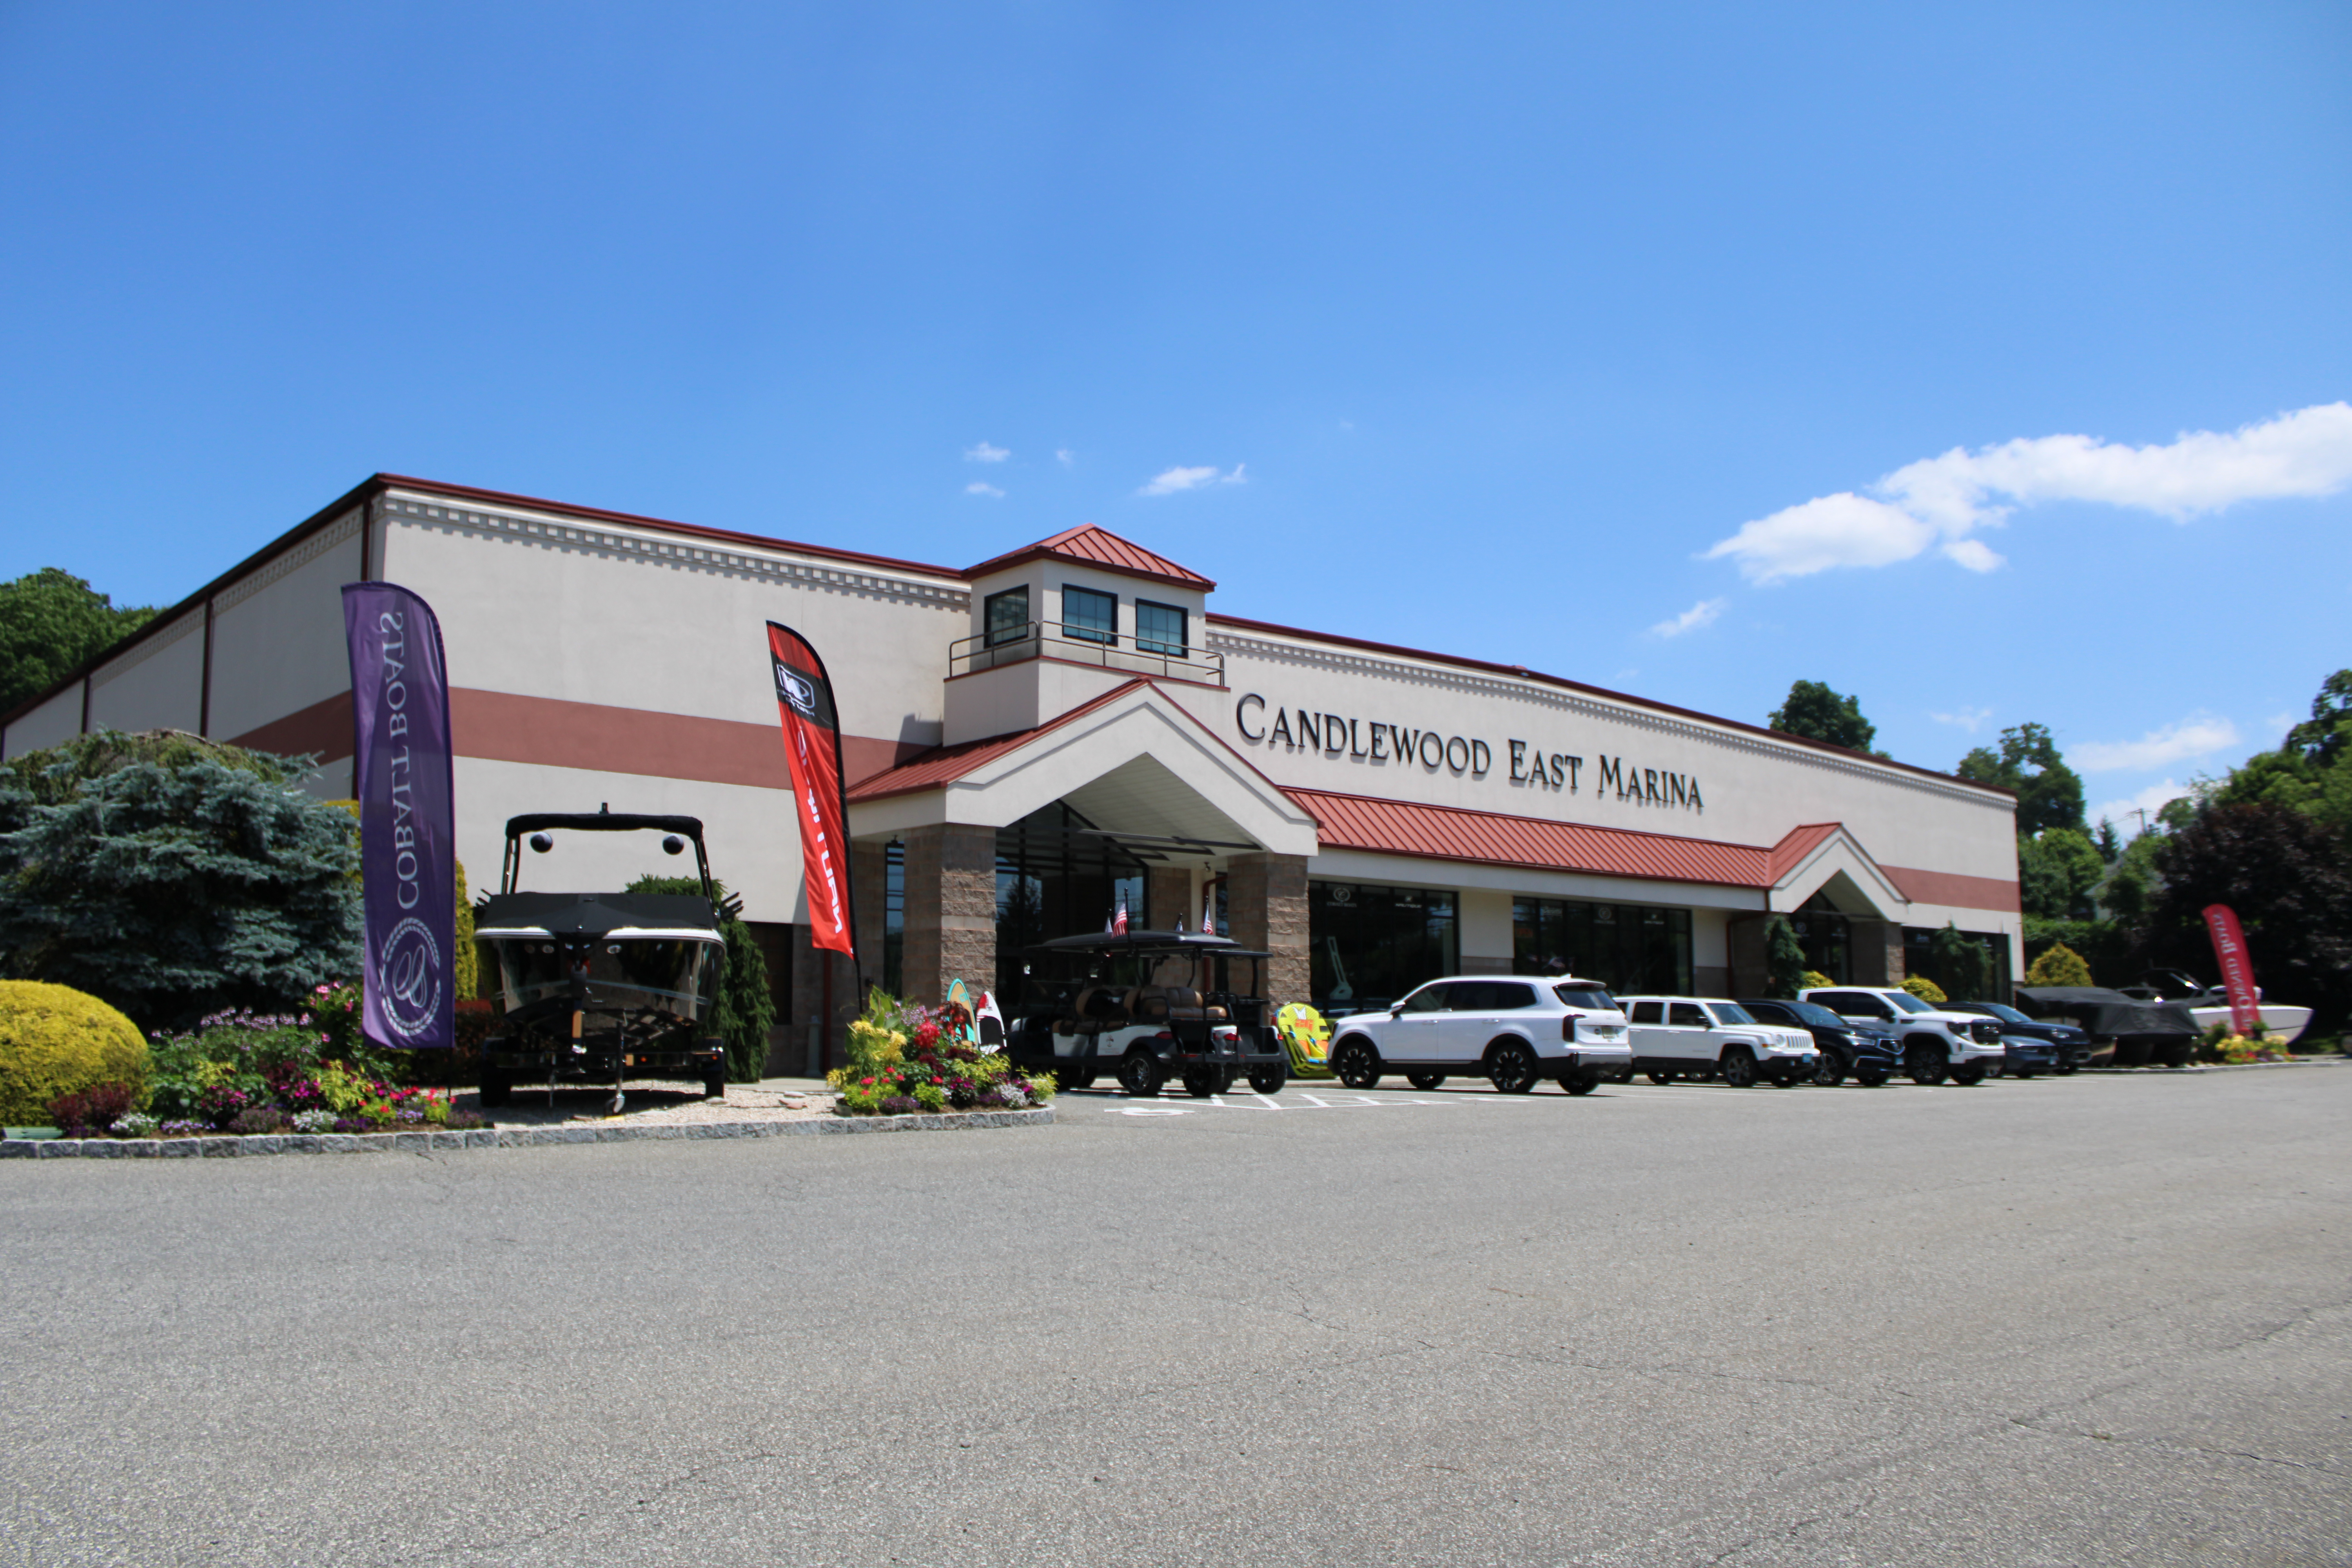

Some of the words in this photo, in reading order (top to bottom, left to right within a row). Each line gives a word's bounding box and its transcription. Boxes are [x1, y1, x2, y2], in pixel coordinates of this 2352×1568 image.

[1236, 693, 1491, 774] CANDLEWOOD
[1509, 739, 1583, 789] EAST
[1599, 755, 1704, 807] MARINA
